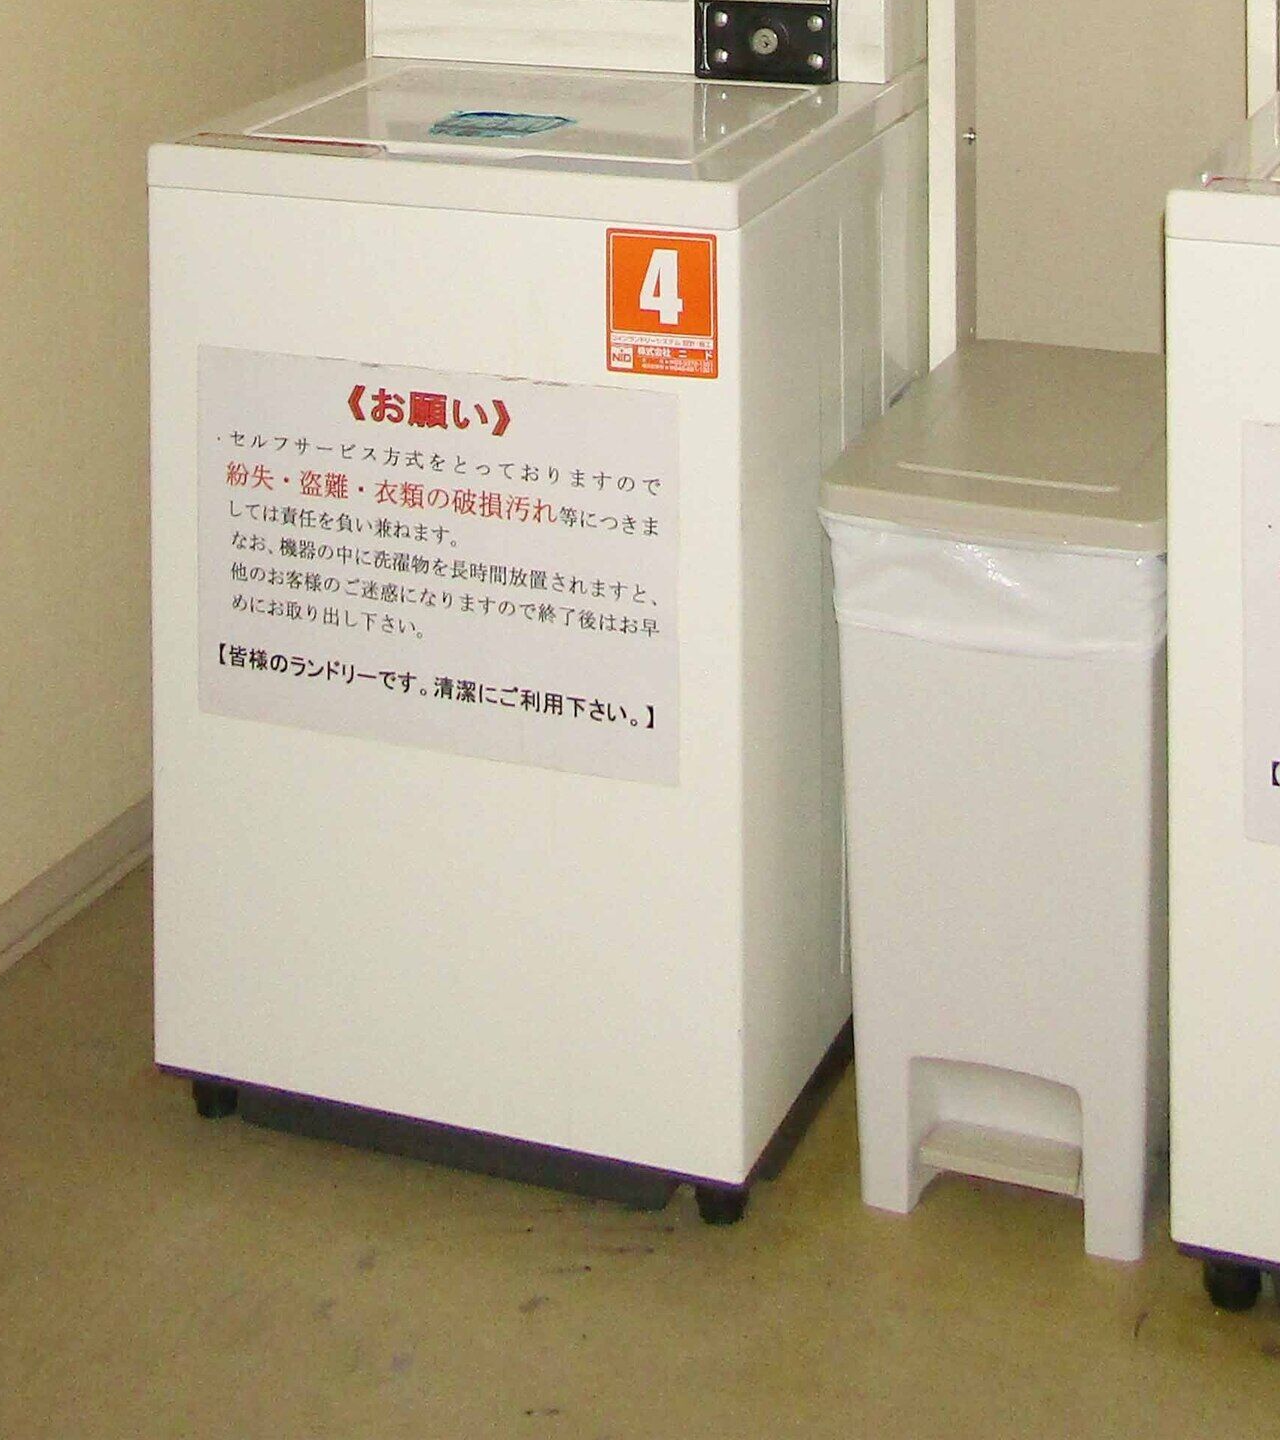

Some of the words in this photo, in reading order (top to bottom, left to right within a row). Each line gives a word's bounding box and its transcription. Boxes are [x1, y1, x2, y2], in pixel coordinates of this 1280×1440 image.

[639, 248, 684, 325] 4
[226, 461, 660, 539] 紛失・盗難・衣類の破損汚れ等につきま
[229, 500, 459, 549] しては責任を負い兼ねます。
[230, 562, 660, 638] 他のお客様のご迷惑になりますので終了後はお早
[231, 531, 659, 607] なお、機器の中に洗濯物を長時間放置されますと、
[231, 593, 426, 641] めにお取り出し下さい。
[218, 642, 656, 731] 【皆様のランドリーです。清潔にご利用下さい。】
